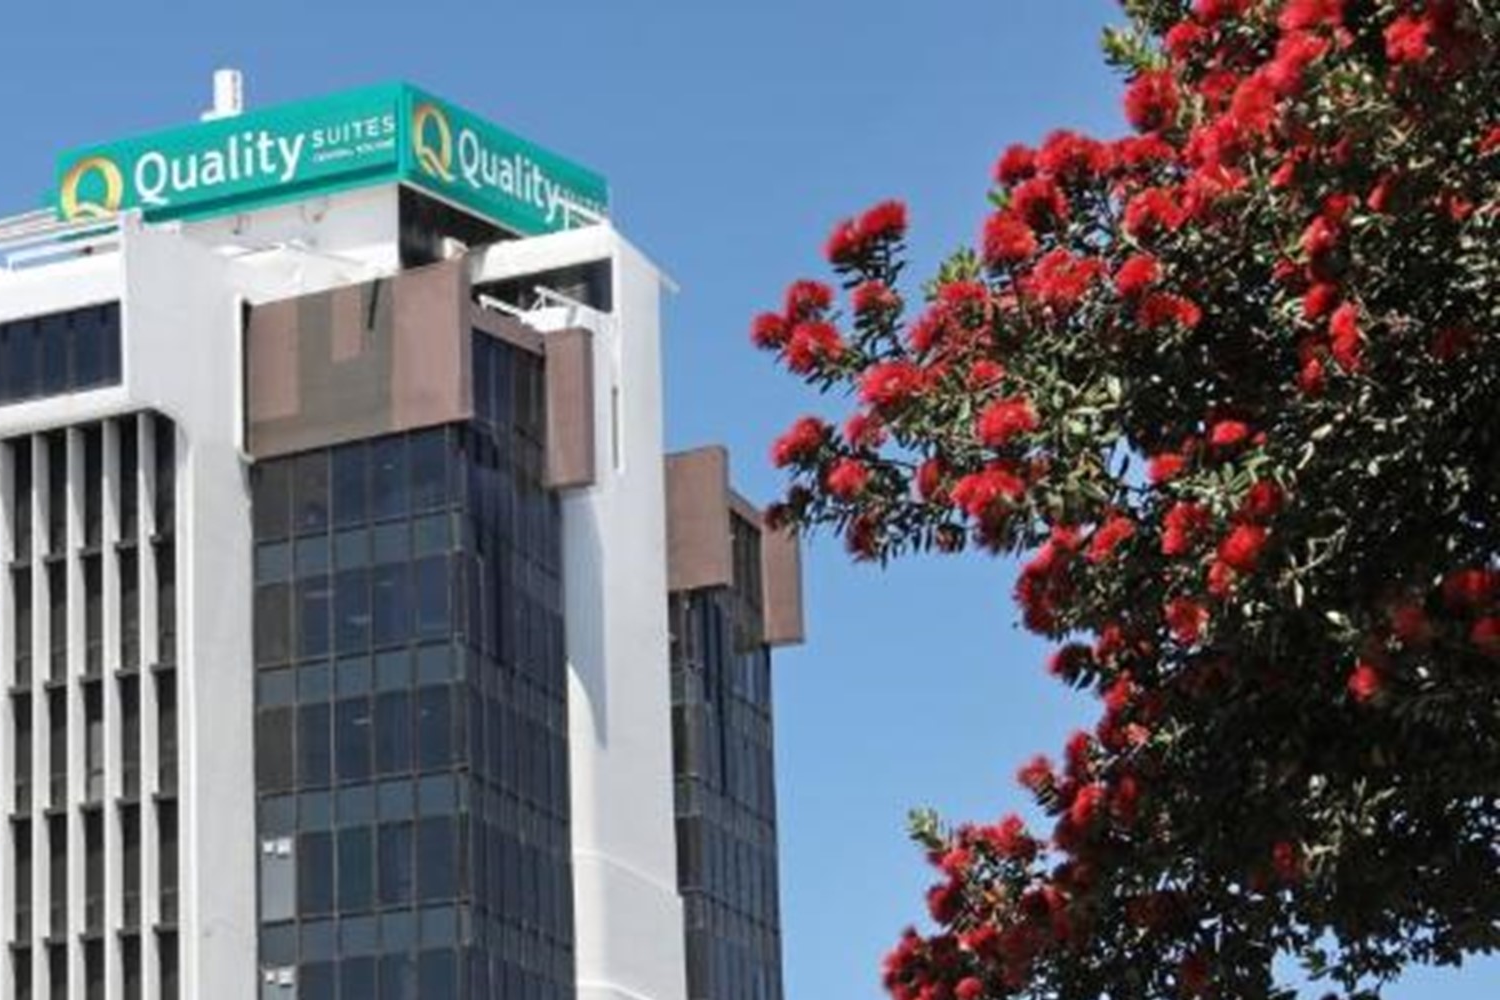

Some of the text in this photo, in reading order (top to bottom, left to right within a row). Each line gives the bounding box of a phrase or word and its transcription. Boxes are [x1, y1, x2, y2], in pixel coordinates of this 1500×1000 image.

[134, 130, 305, 204] Quality
[312, 114, 396, 149] SUITES
[458, 129, 560, 223] Quality
